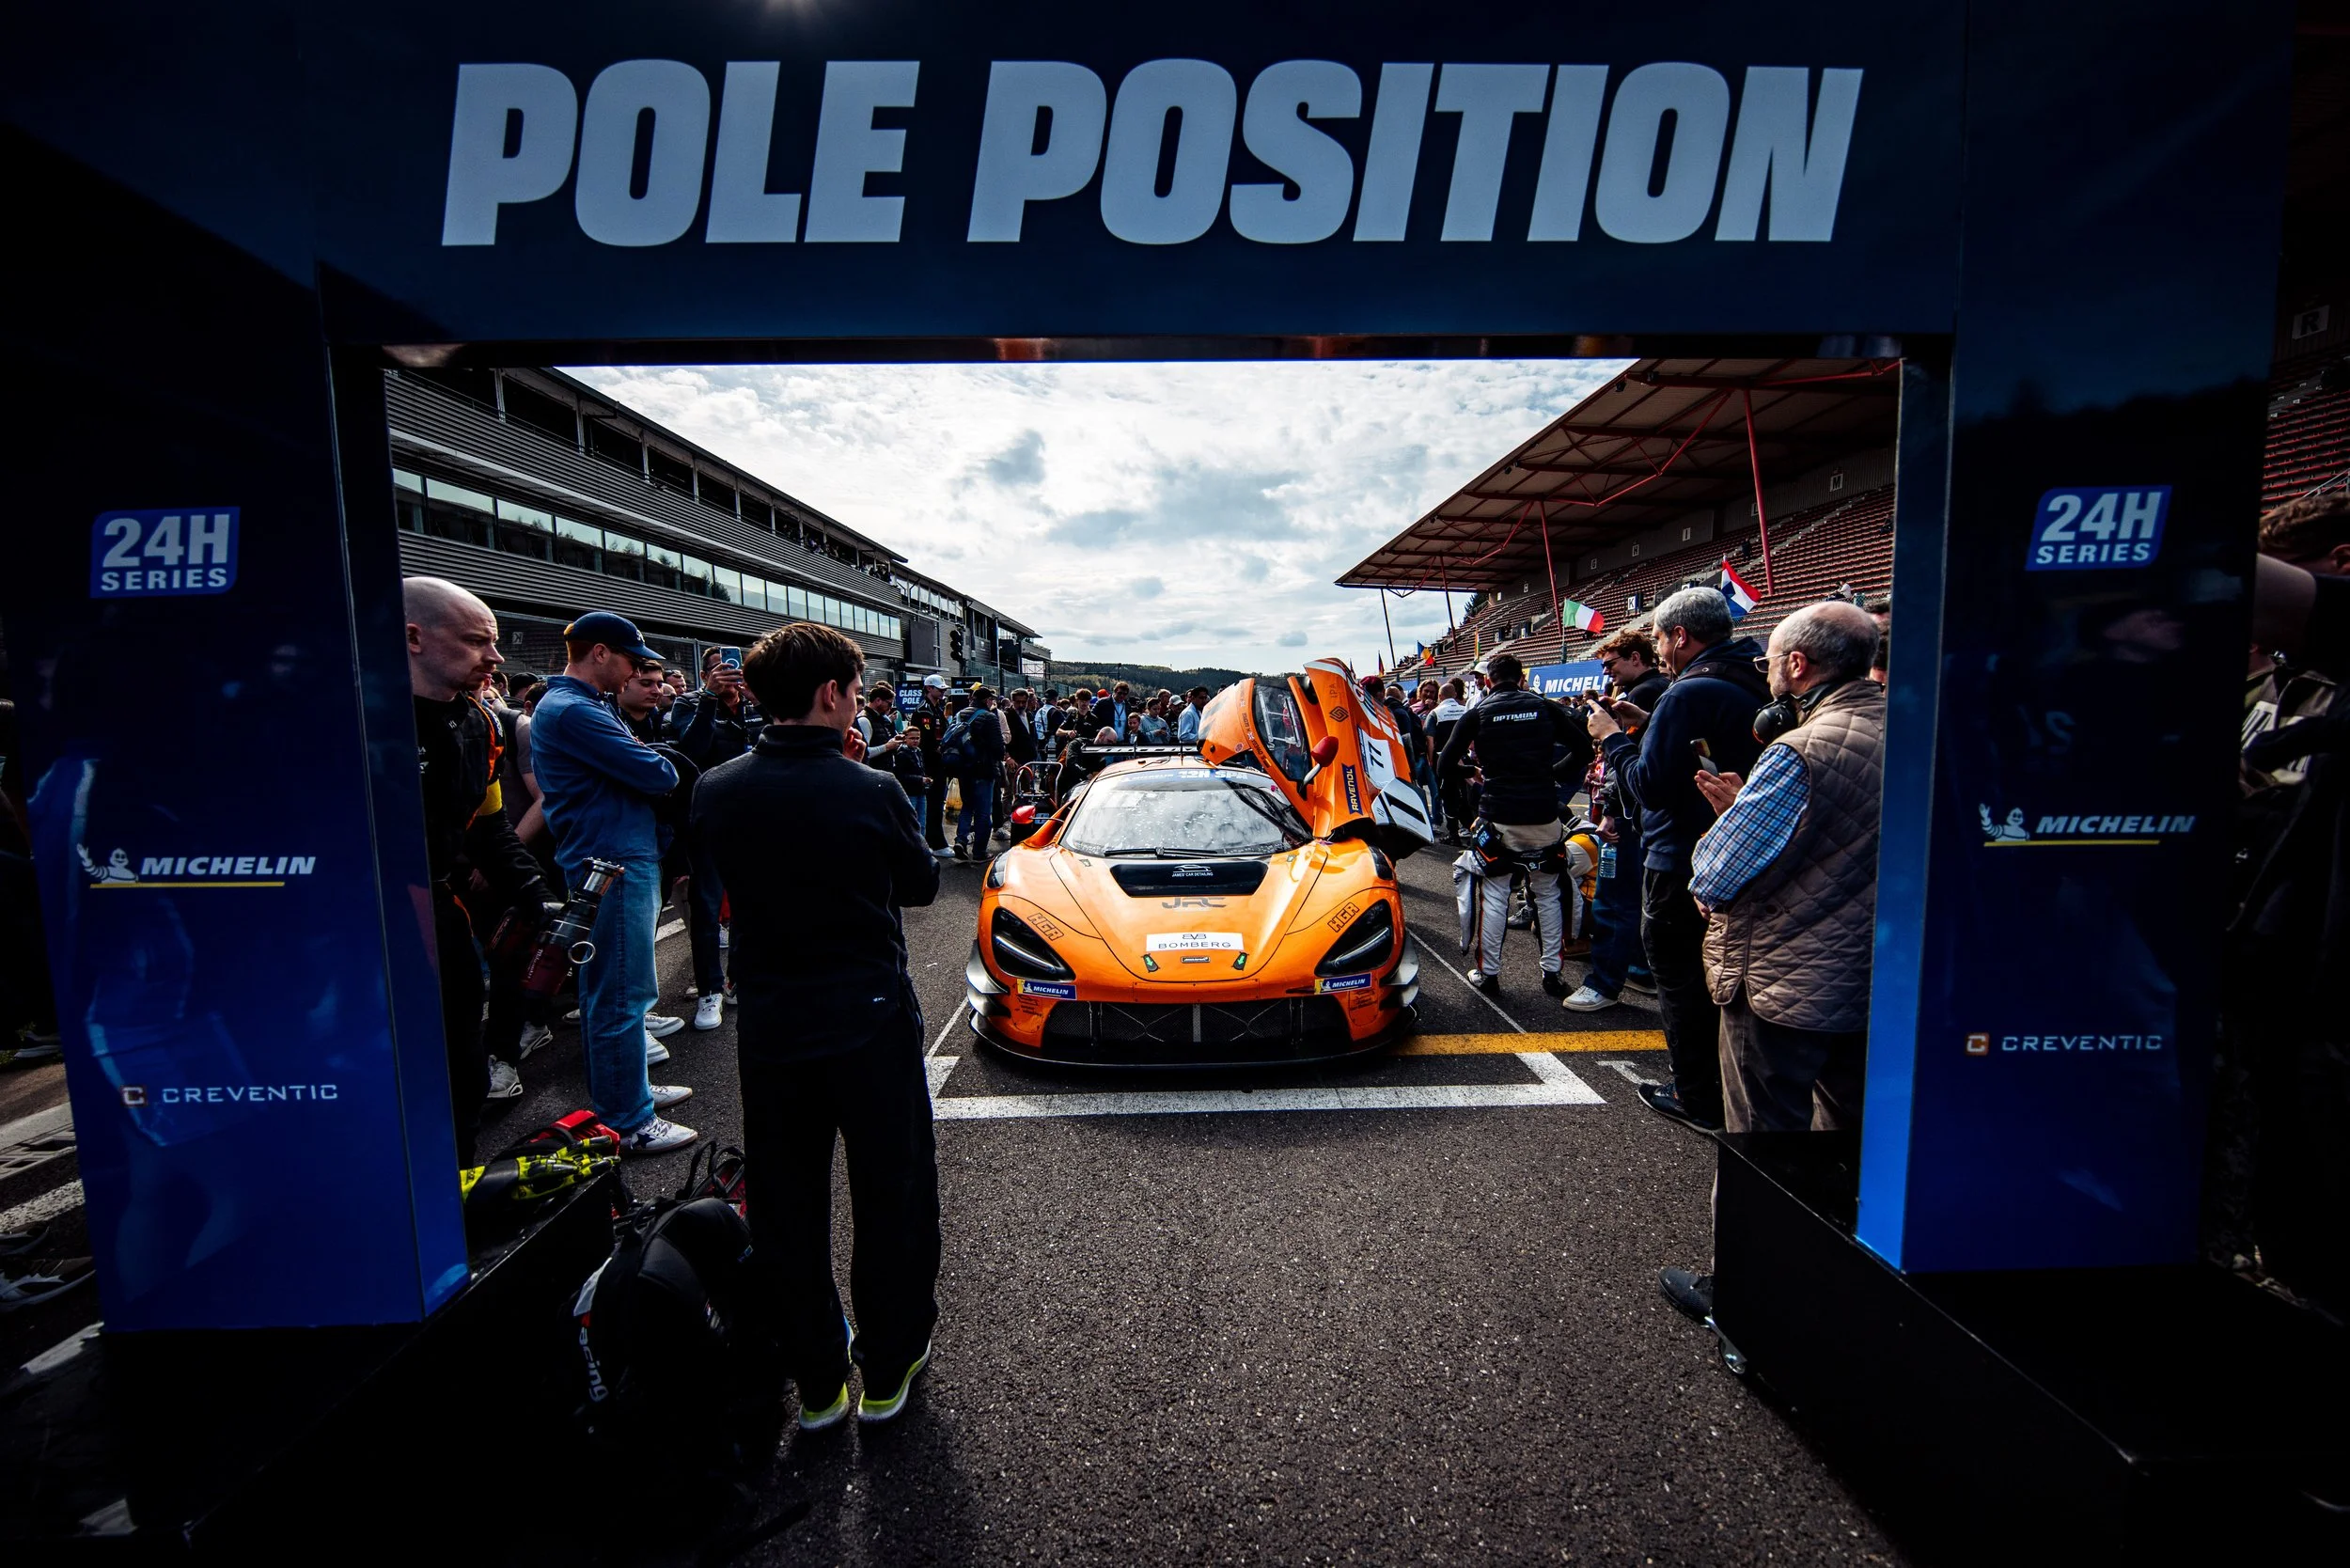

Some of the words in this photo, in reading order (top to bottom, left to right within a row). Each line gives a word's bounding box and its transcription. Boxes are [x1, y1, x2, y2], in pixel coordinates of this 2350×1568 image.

[442, 59, 919, 246] POLE
[967, 59, 1863, 244] POSITION
[2040, 493, 2161, 541] 24H
[102, 514, 229, 567] 24H
[2035, 543, 2150, 564] SERIES
[101, 568, 227, 590] SERIES
[1544, 675, 1607, 693] MICHELI
[899, 689, 923, 698] CLASS
[1493, 712, 1538, 722] OPTIMUM
[1368, 741, 1385, 769] 77
[1214, 771, 1248, 779] SPA
[1347, 768, 1359, 811] RAVENOL
[2036, 816, 2195, 833] MICHELIN
[140, 856, 317, 875] MICHELIN
[1327, 902, 1360, 933] HGR
[1026, 912, 1065, 942] HGR
[1158, 941, 1231, 949] BOMBERG
[1033, 985, 1069, 996] MICHELIN
[1332, 978, 1366, 988] MICHELIN
[2001, 1036, 2162, 1051] CREVENTIC
[162, 1085, 339, 1103] CREVENTIC
